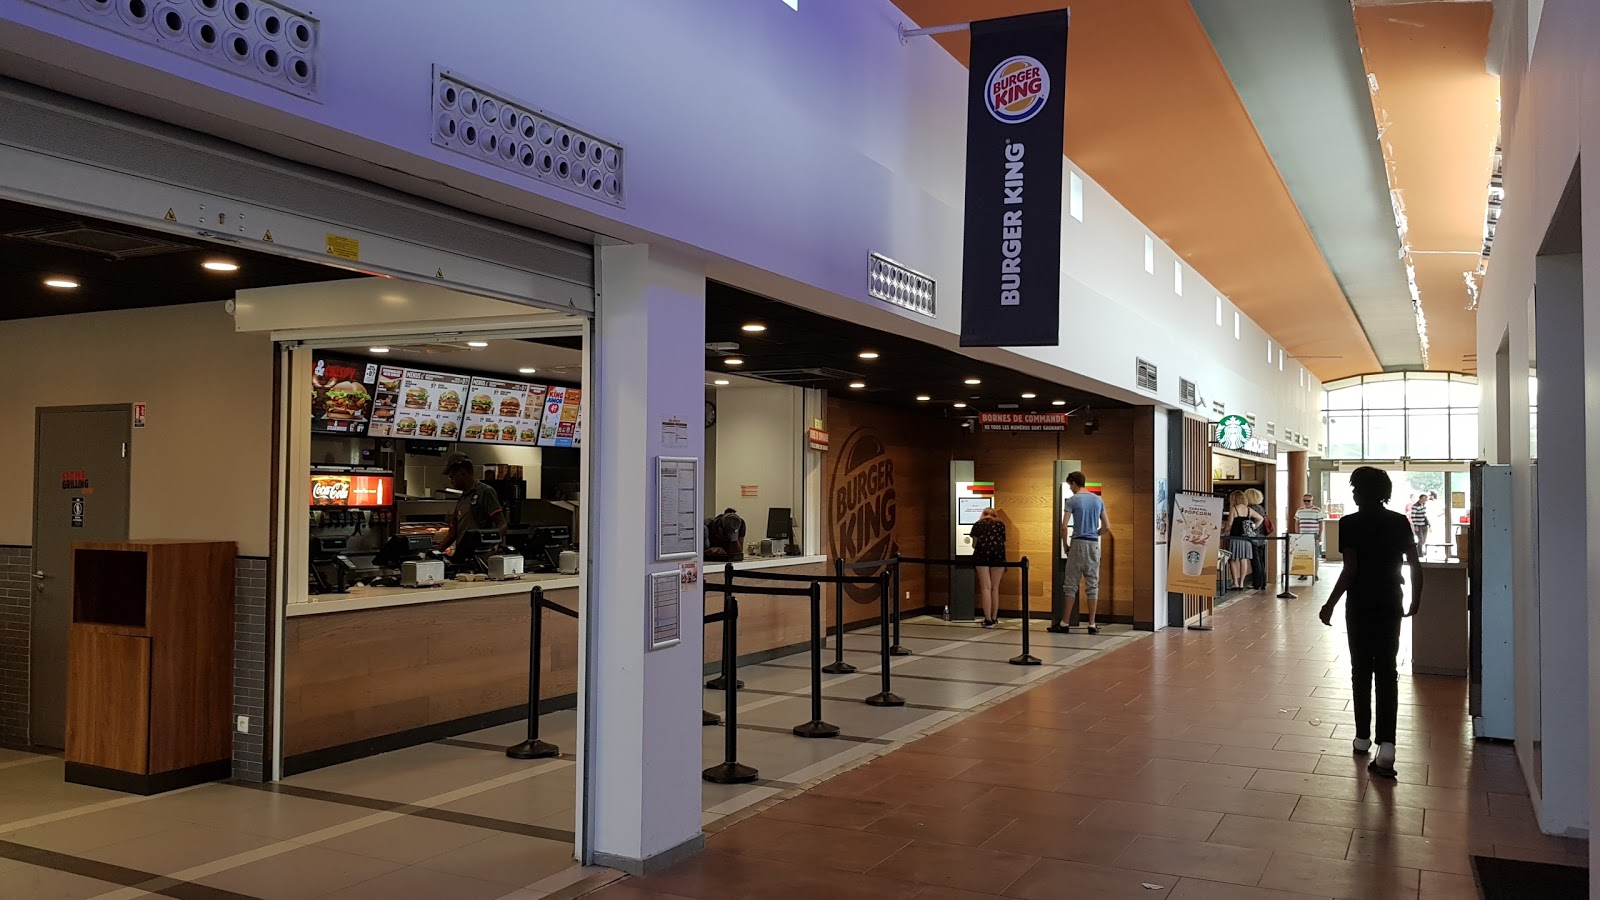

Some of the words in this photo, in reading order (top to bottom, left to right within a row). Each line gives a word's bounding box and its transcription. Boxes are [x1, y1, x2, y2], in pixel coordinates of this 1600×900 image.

[993, 67, 1040, 95] BURGER
[995, 78, 1042, 110] KING
[1004, 142, 1025, 204] KING
[1001, 210, 1022, 306] BURGER
[549, 390, 564, 398] KING
[982, 414, 1011, 422] BORNES
[1013, 414, 1022, 422] DE
[1025, 415, 1065, 423] COMMANDE
[837, 458, 894, 524] BURGER
[839, 488, 896, 559] KING
